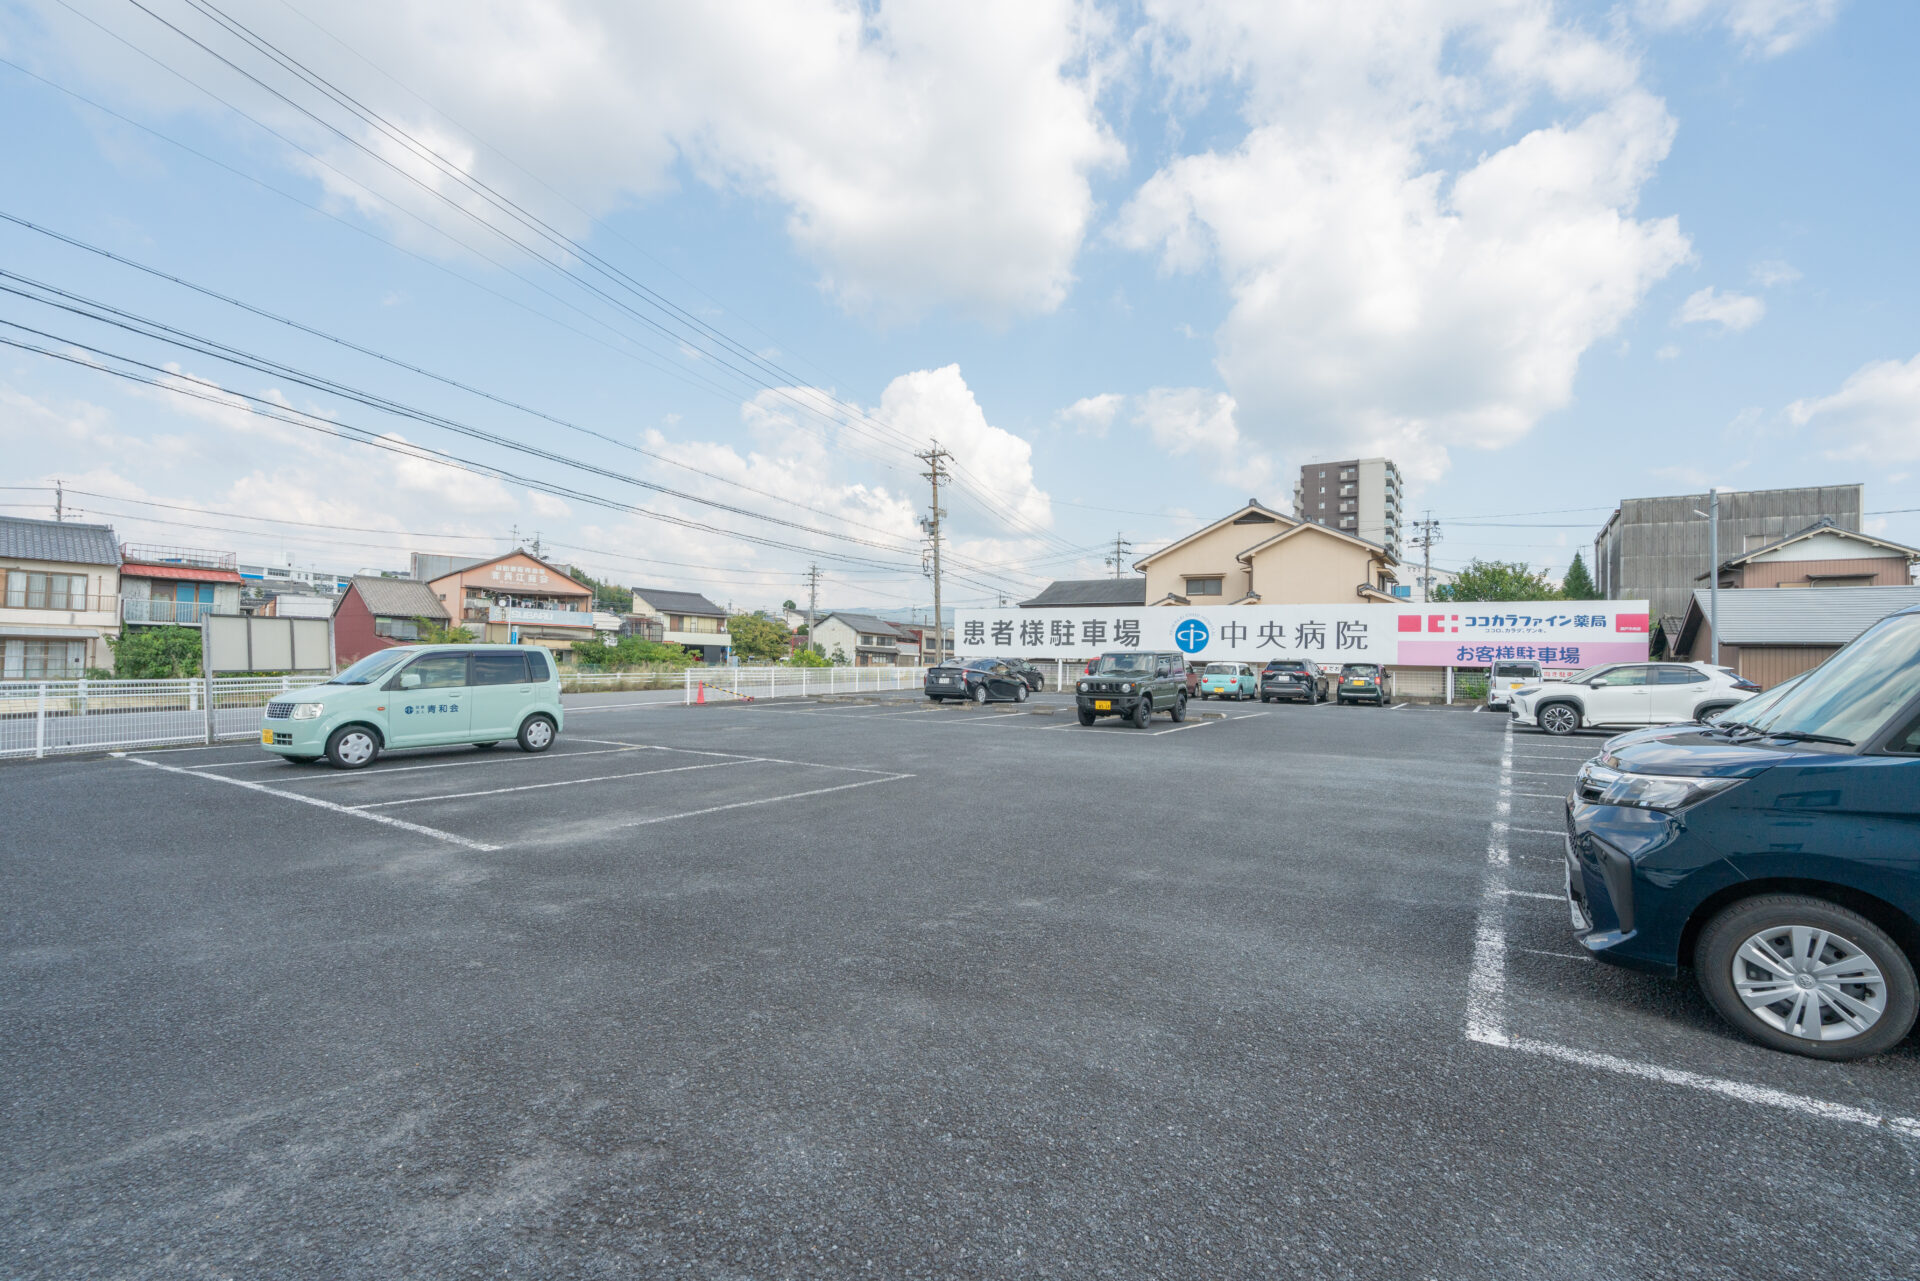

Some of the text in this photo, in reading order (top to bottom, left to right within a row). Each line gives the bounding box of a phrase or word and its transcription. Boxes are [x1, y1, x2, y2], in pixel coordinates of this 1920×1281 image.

[1465, 614, 1607, 628] ココカラファイン薬局
[963, 619, 1141, 647] 患者様駐車場
[1221, 620, 1369, 650] 中央病院
[1456, 646, 1580, 664] お客様駐車場
